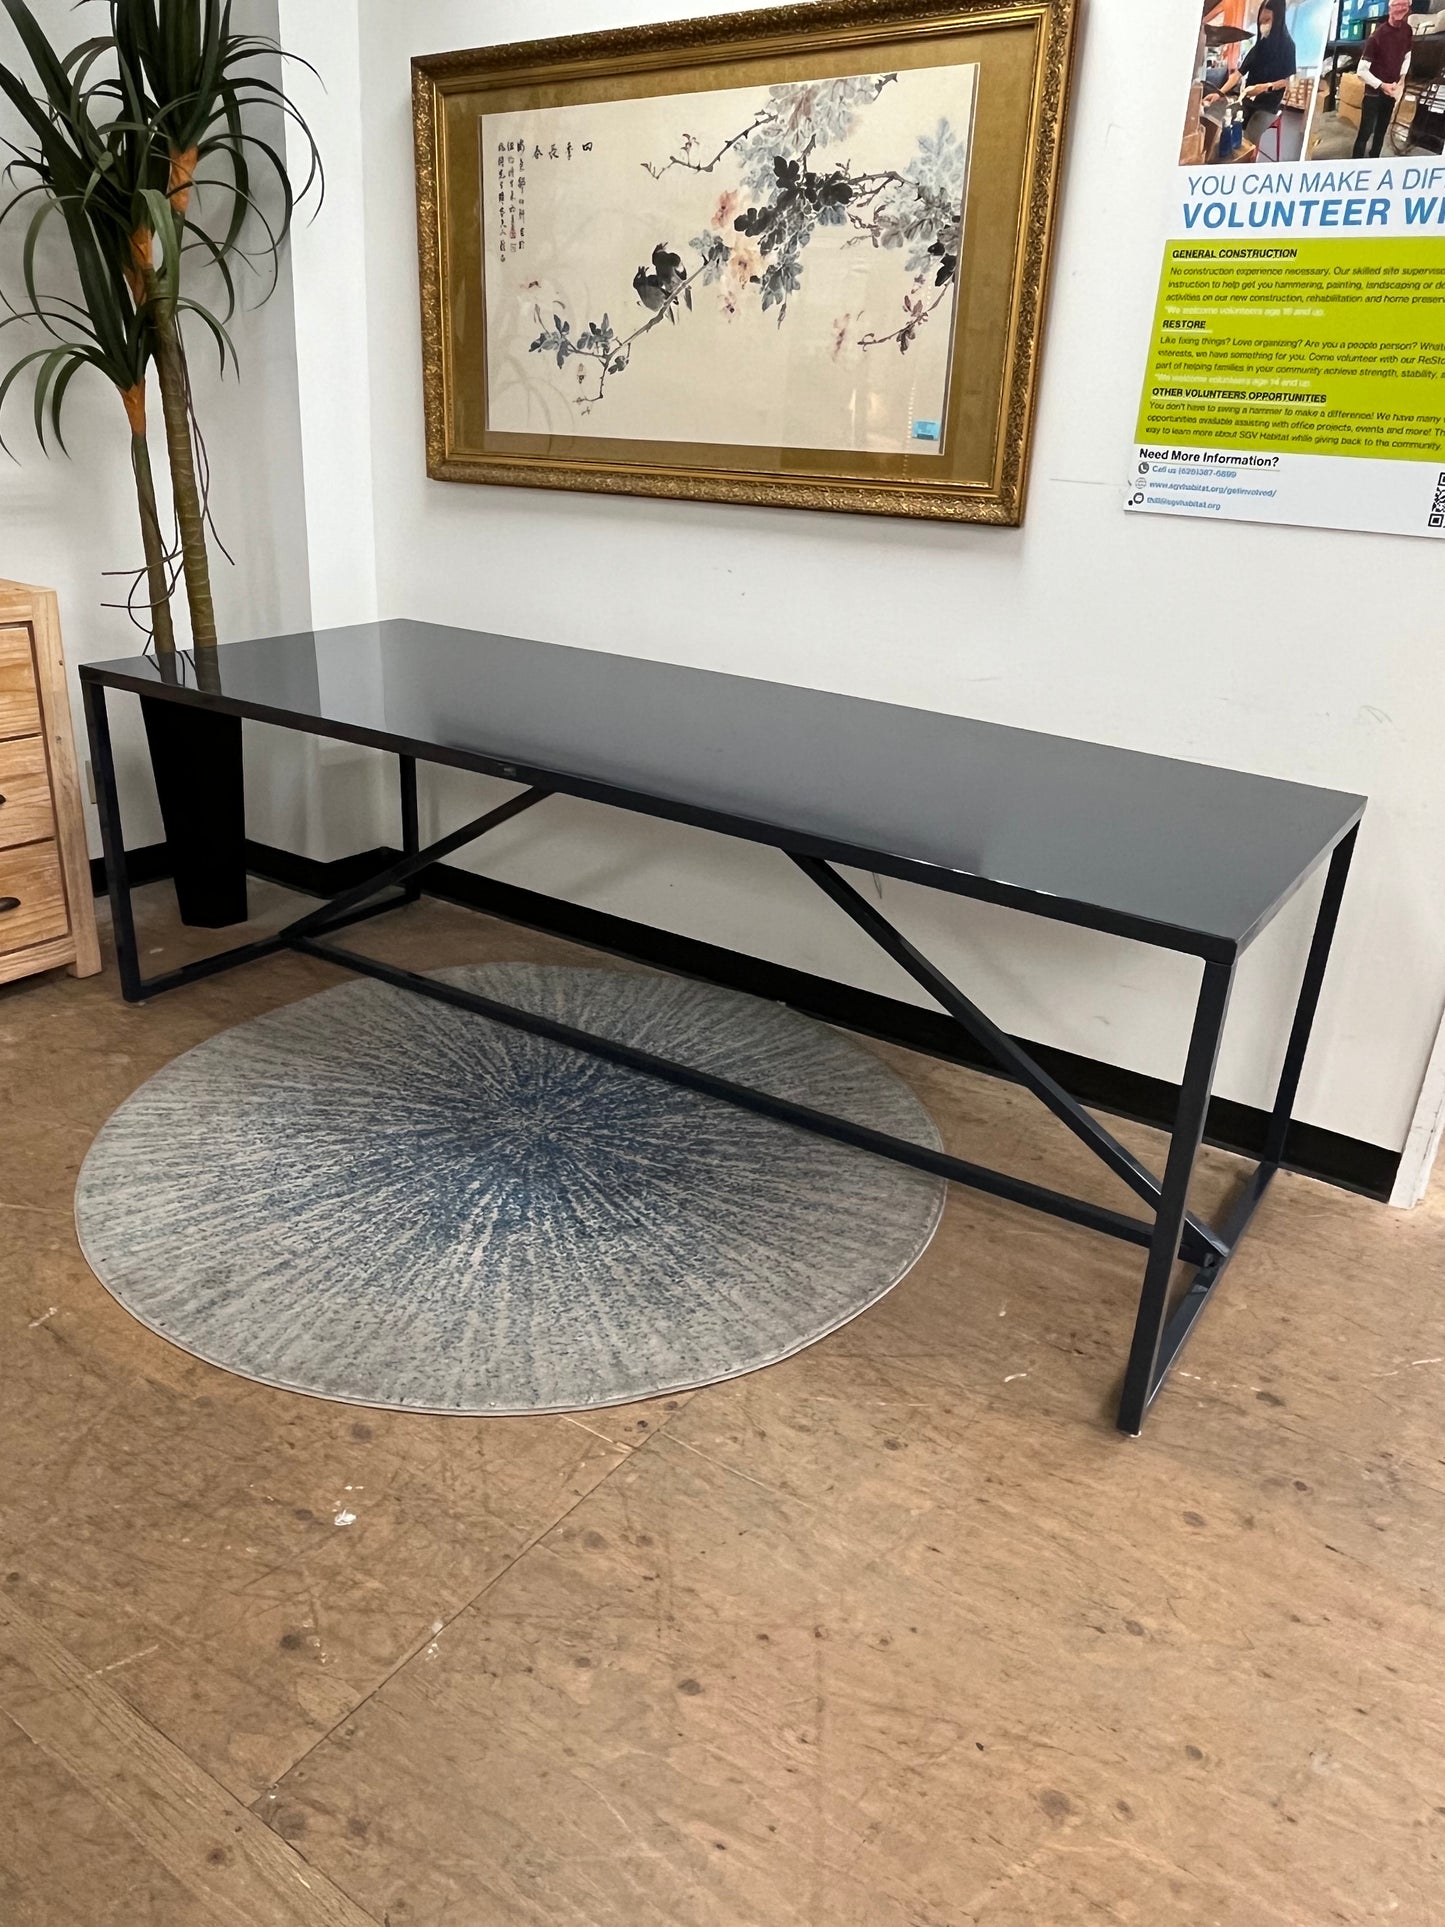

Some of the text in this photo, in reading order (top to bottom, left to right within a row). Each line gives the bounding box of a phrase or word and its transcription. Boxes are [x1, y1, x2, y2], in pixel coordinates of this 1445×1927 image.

[1188, 167, 1445, 196] YOU CAN MAKE A DIF
[1183, 198, 1391, 229] VOLUNTEER
[1172, 249, 1297, 258] GENERAL CONSTRUCTION
[1171, 267, 1182, 275] No
[1184, 267, 1234, 276] construction
[1236, 268, 1282, 277] experience
[1333, 266, 1350, 275] Our
[1352, 267, 1381, 275] skilled
[1383, 267, 1399, 275] site
[1168, 281, 1210, 289] instruction
[1212, 281, 1220, 289] to
[1222, 281, 1240, 290] help
[1241, 282, 1255, 290] get
[1257, 282, 1272, 290] you
[1365, 281, 1420, 290] landscaping
[1166, 294, 1201, 302] activities
[1249, 294, 1304, 303] construction,
[1306, 294, 1362, 303] rehabilitation
[1364, 295, 1382, 303] and
[1383, 295, 1409, 303] home
[1162, 319, 1206, 329] RESTORE
[1160, 337, 1176, 345] Like
[1201, 337, 1230, 346] things?
[1232, 337, 1252, 346] Love
[1253, 338, 1302, 349] organizing?
[1304, 340, 1320, 348] Are
[1321, 341, 1338, 349] you
[1347, 341, 1378, 350] people
[1379, 342, 1418, 351] person?
[1157, 350, 1193, 358] interests,
[1209, 351, 1228, 359] have
[1230, 351, 1273, 361] something
[1275, 352, 1287, 360] for
[1308, 352, 1334, 362] Come
[1336, 353, 1377, 363] volunteer
[1379, 355, 1399, 363] with
[1400, 356, 1416, 364] our
[1155, 362, 1172, 370] part
[1173, 362, 1182, 370] of
[1183, 362, 1212, 372] helping
[1214, 363, 1244, 372] families
[1246, 364, 1254, 372] in
[1255, 365, 1273, 373] your
[1275, 366, 1322, 376] community
[1323, 367, 1358, 376] achieve
[1359, 368, 1399, 378] strength,
[1152, 387, 1327, 403] OTHER VOLUNTEERS OPPORTUNITIES
[1150, 401, 1165, 409] You
[1165, 402, 1185, 411] don't
[1187, 403, 1205, 411] have
[1207, 404, 1216, 412] to
[1217, 405, 1240, 414] swing
[1249, 406, 1283, 415] hammer
[1284, 408, 1293, 416] to
[1295, 409, 1319, 417] make
[1327, 410, 1374, 419] difference!
[1376, 412, 1390, 421] We
[1392, 413, 1414, 422] have
[1416, 415, 1441, 424] many
[1147, 414, 1197, 424] opportunities
[1199, 416, 1233, 425] available
[1234, 418, 1270, 429] assisting
[1271, 420, 1289, 429] with
[1290, 421, 1315, 430] office
[1316, 423, 1353, 432] projects,
[1355, 425, 1384, 434] events
[1386, 426, 1404, 435] and
[1162, 427, 1171, 435] to
[1192, 429, 1213, 437] more
[1214, 429, 1238, 438] about
[1239, 430, 1259, 439] SGV
[1259, 431, 1289, 441] Habitat
[1291, 433, 1313, 442] while
[1314, 436, 1339, 445] giving
[1340, 436, 1361, 445] back
[1364, 438, 1374, 446] to
[1375, 438, 1390, 447] the
[1139, 448, 1279, 467] Need More Information?
[1152, 465, 1167, 473] Call
